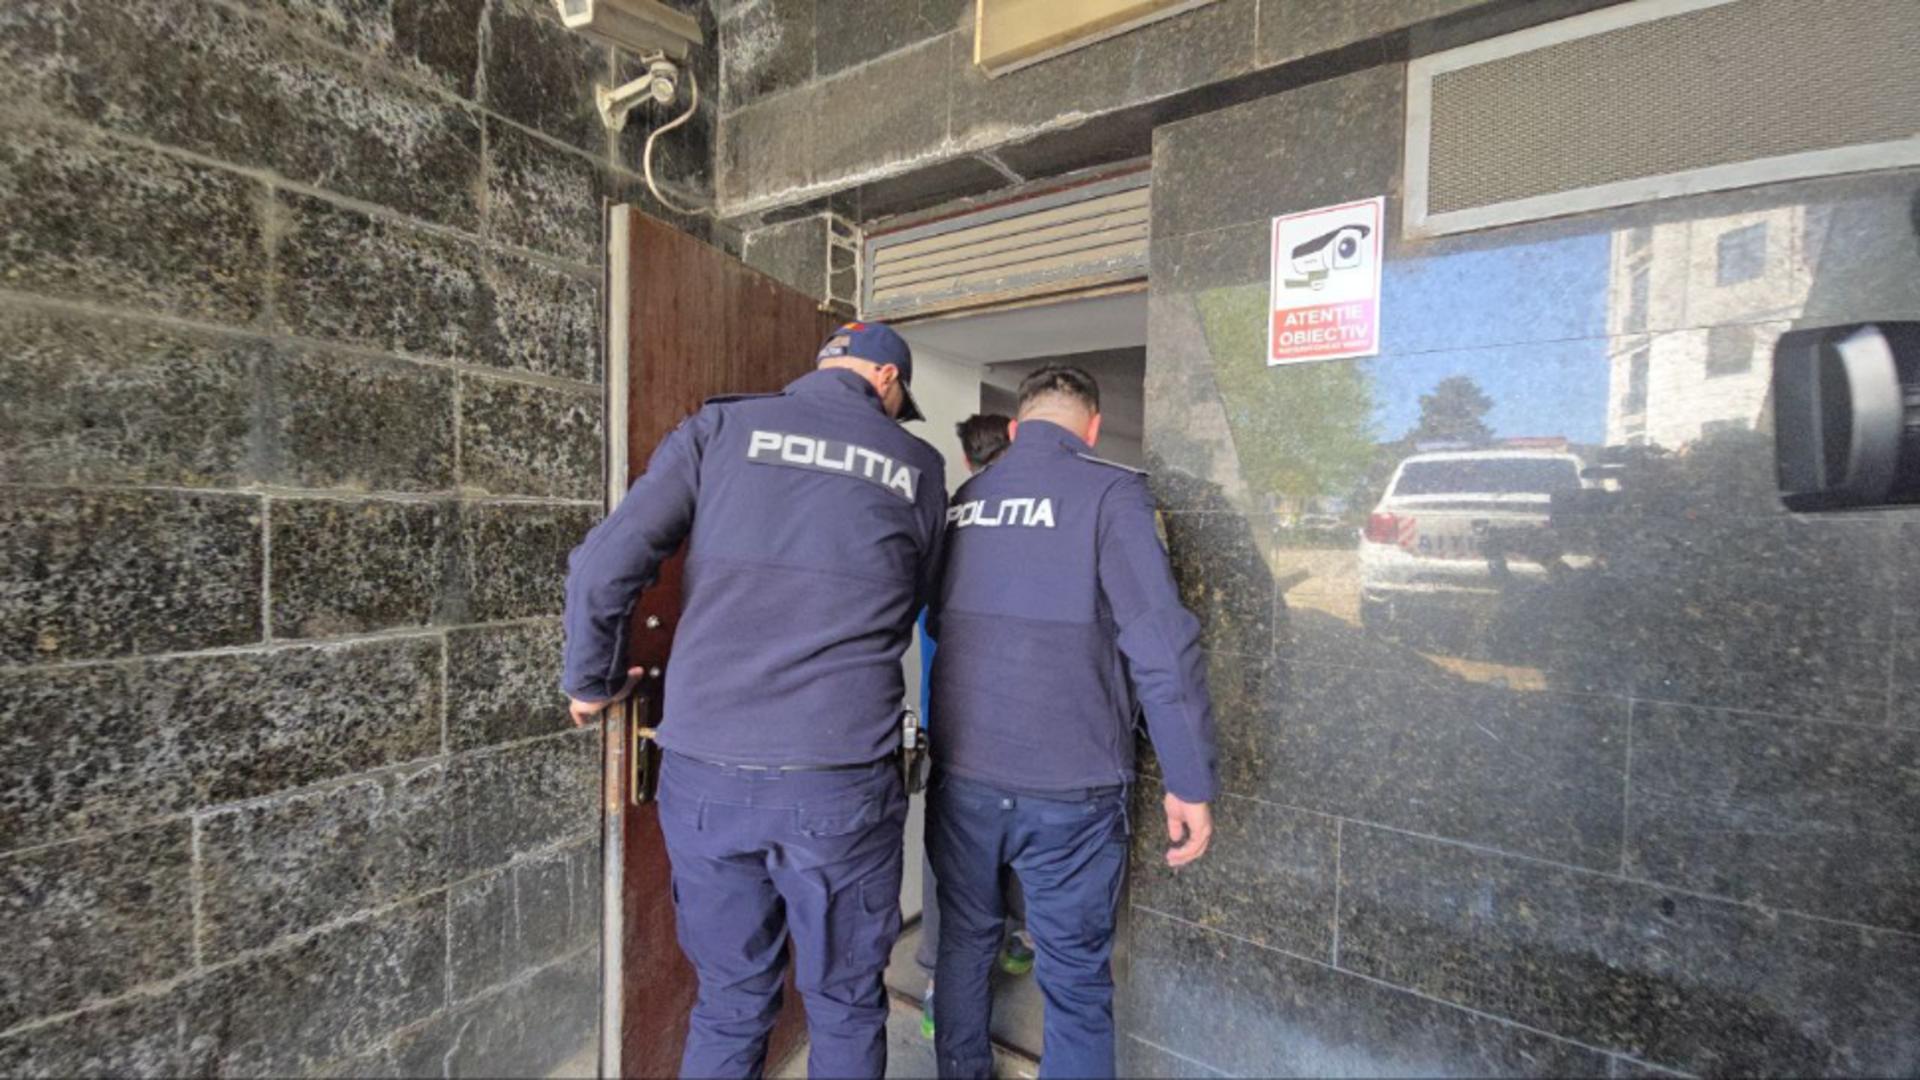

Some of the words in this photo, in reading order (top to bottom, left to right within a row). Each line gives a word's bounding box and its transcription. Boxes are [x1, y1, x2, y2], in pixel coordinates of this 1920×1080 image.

[1279, 323, 1368, 345] OBIECTIV
[747, 430, 915, 503] POLITIA
[944, 498, 1055, 529] POLITIA
